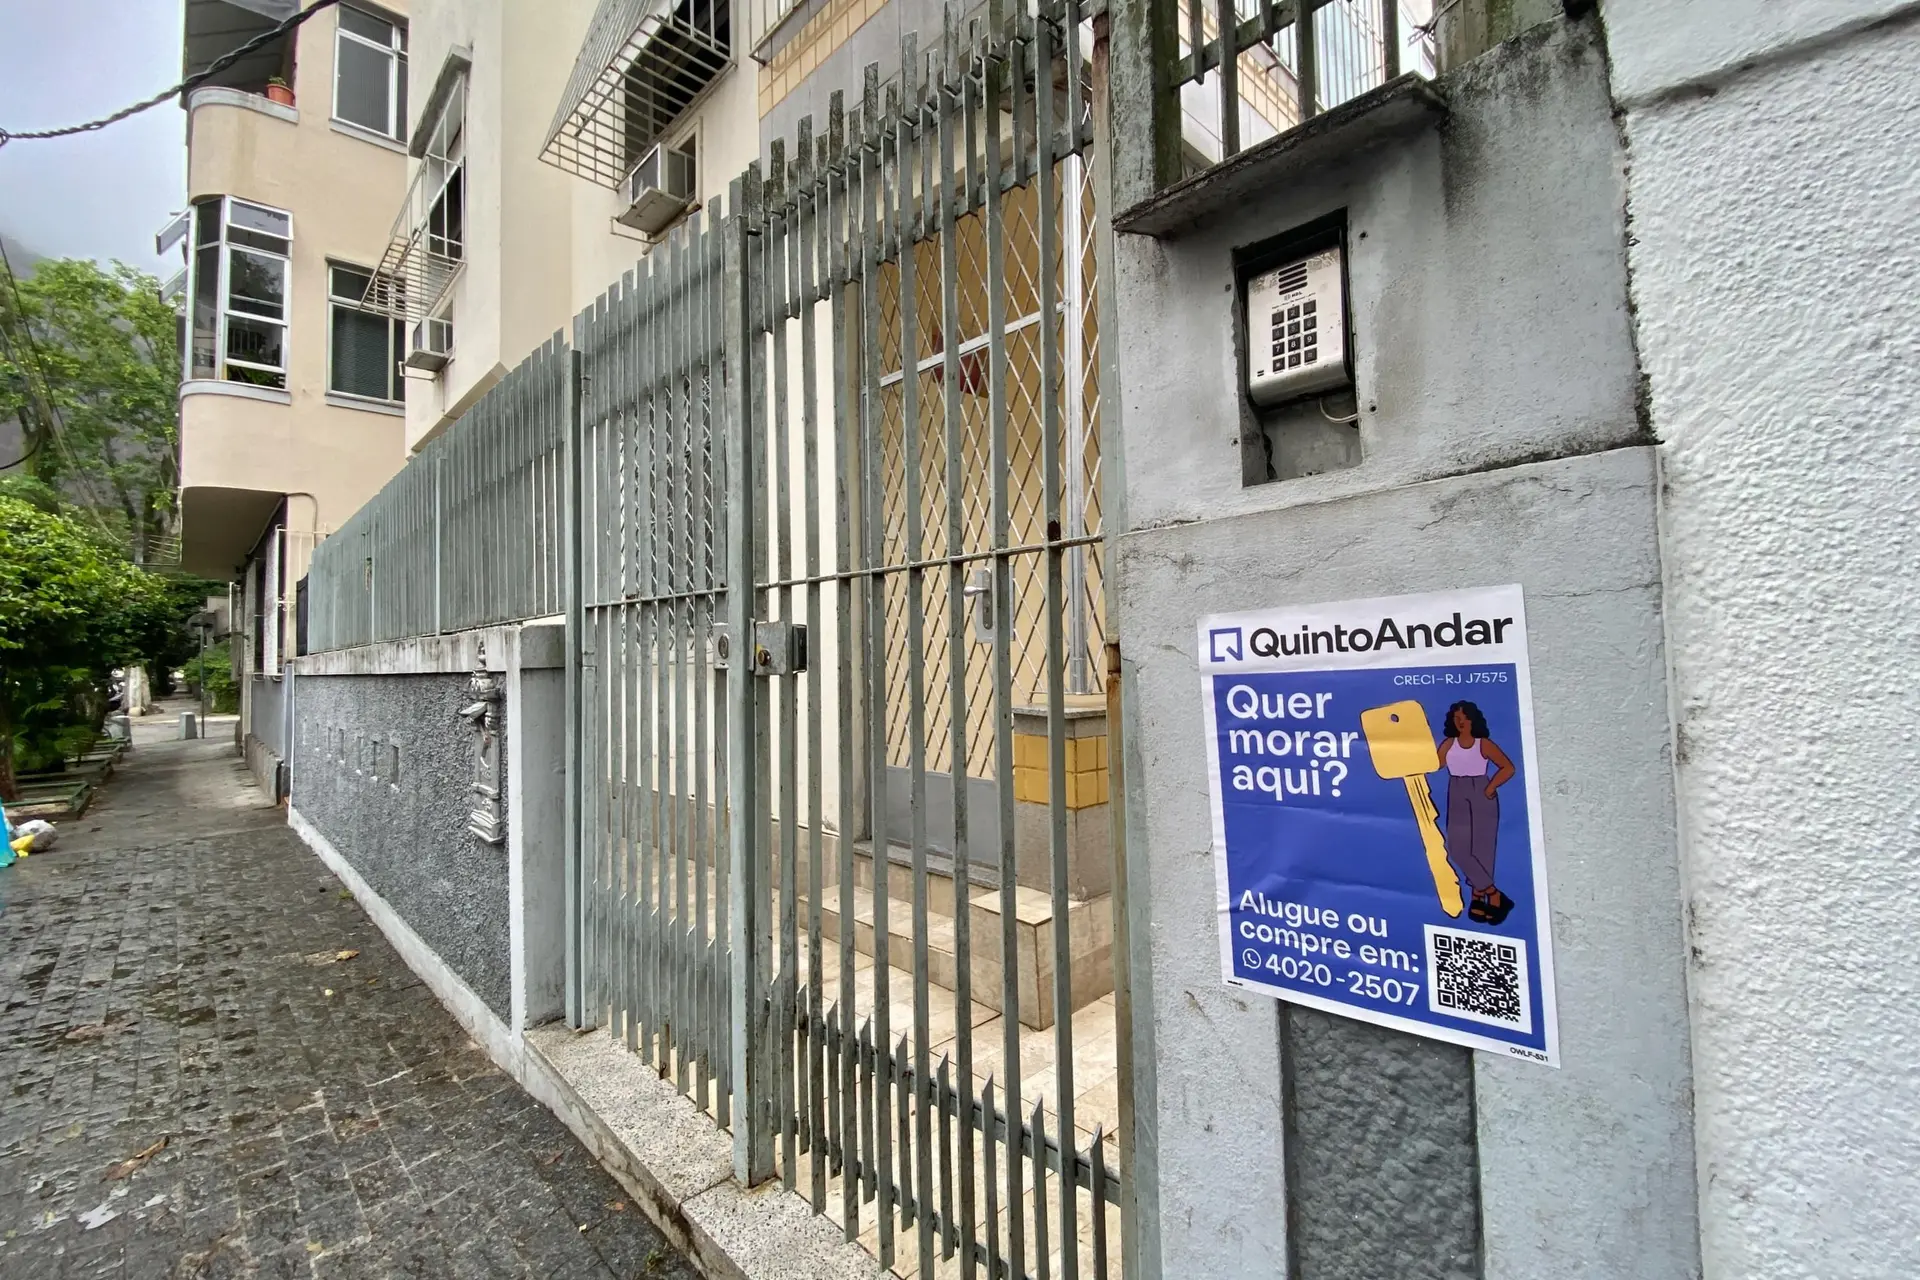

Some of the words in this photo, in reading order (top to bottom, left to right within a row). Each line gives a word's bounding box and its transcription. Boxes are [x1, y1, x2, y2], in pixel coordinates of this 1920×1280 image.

[1275, 345, 1281, 353] 7
[1291, 340, 1297, 348] 8
[1306, 335, 1312, 343] 9
[1249, 612, 1513, 659] QuintoAndar
[1393, 673, 1462, 686] CRECI-RJ
[1465, 671, 1508, 684] J7575
[1226, 684, 1333, 719] Quer
[1229, 728, 1359, 759] morar
[1232, 760, 1348, 801] aqui?
[1239, 889, 1340, 930] Alugue
[1347, 914, 1388, 938] ou
[1239, 920, 1352, 964] compre
[1359, 946, 1420, 973] em:
